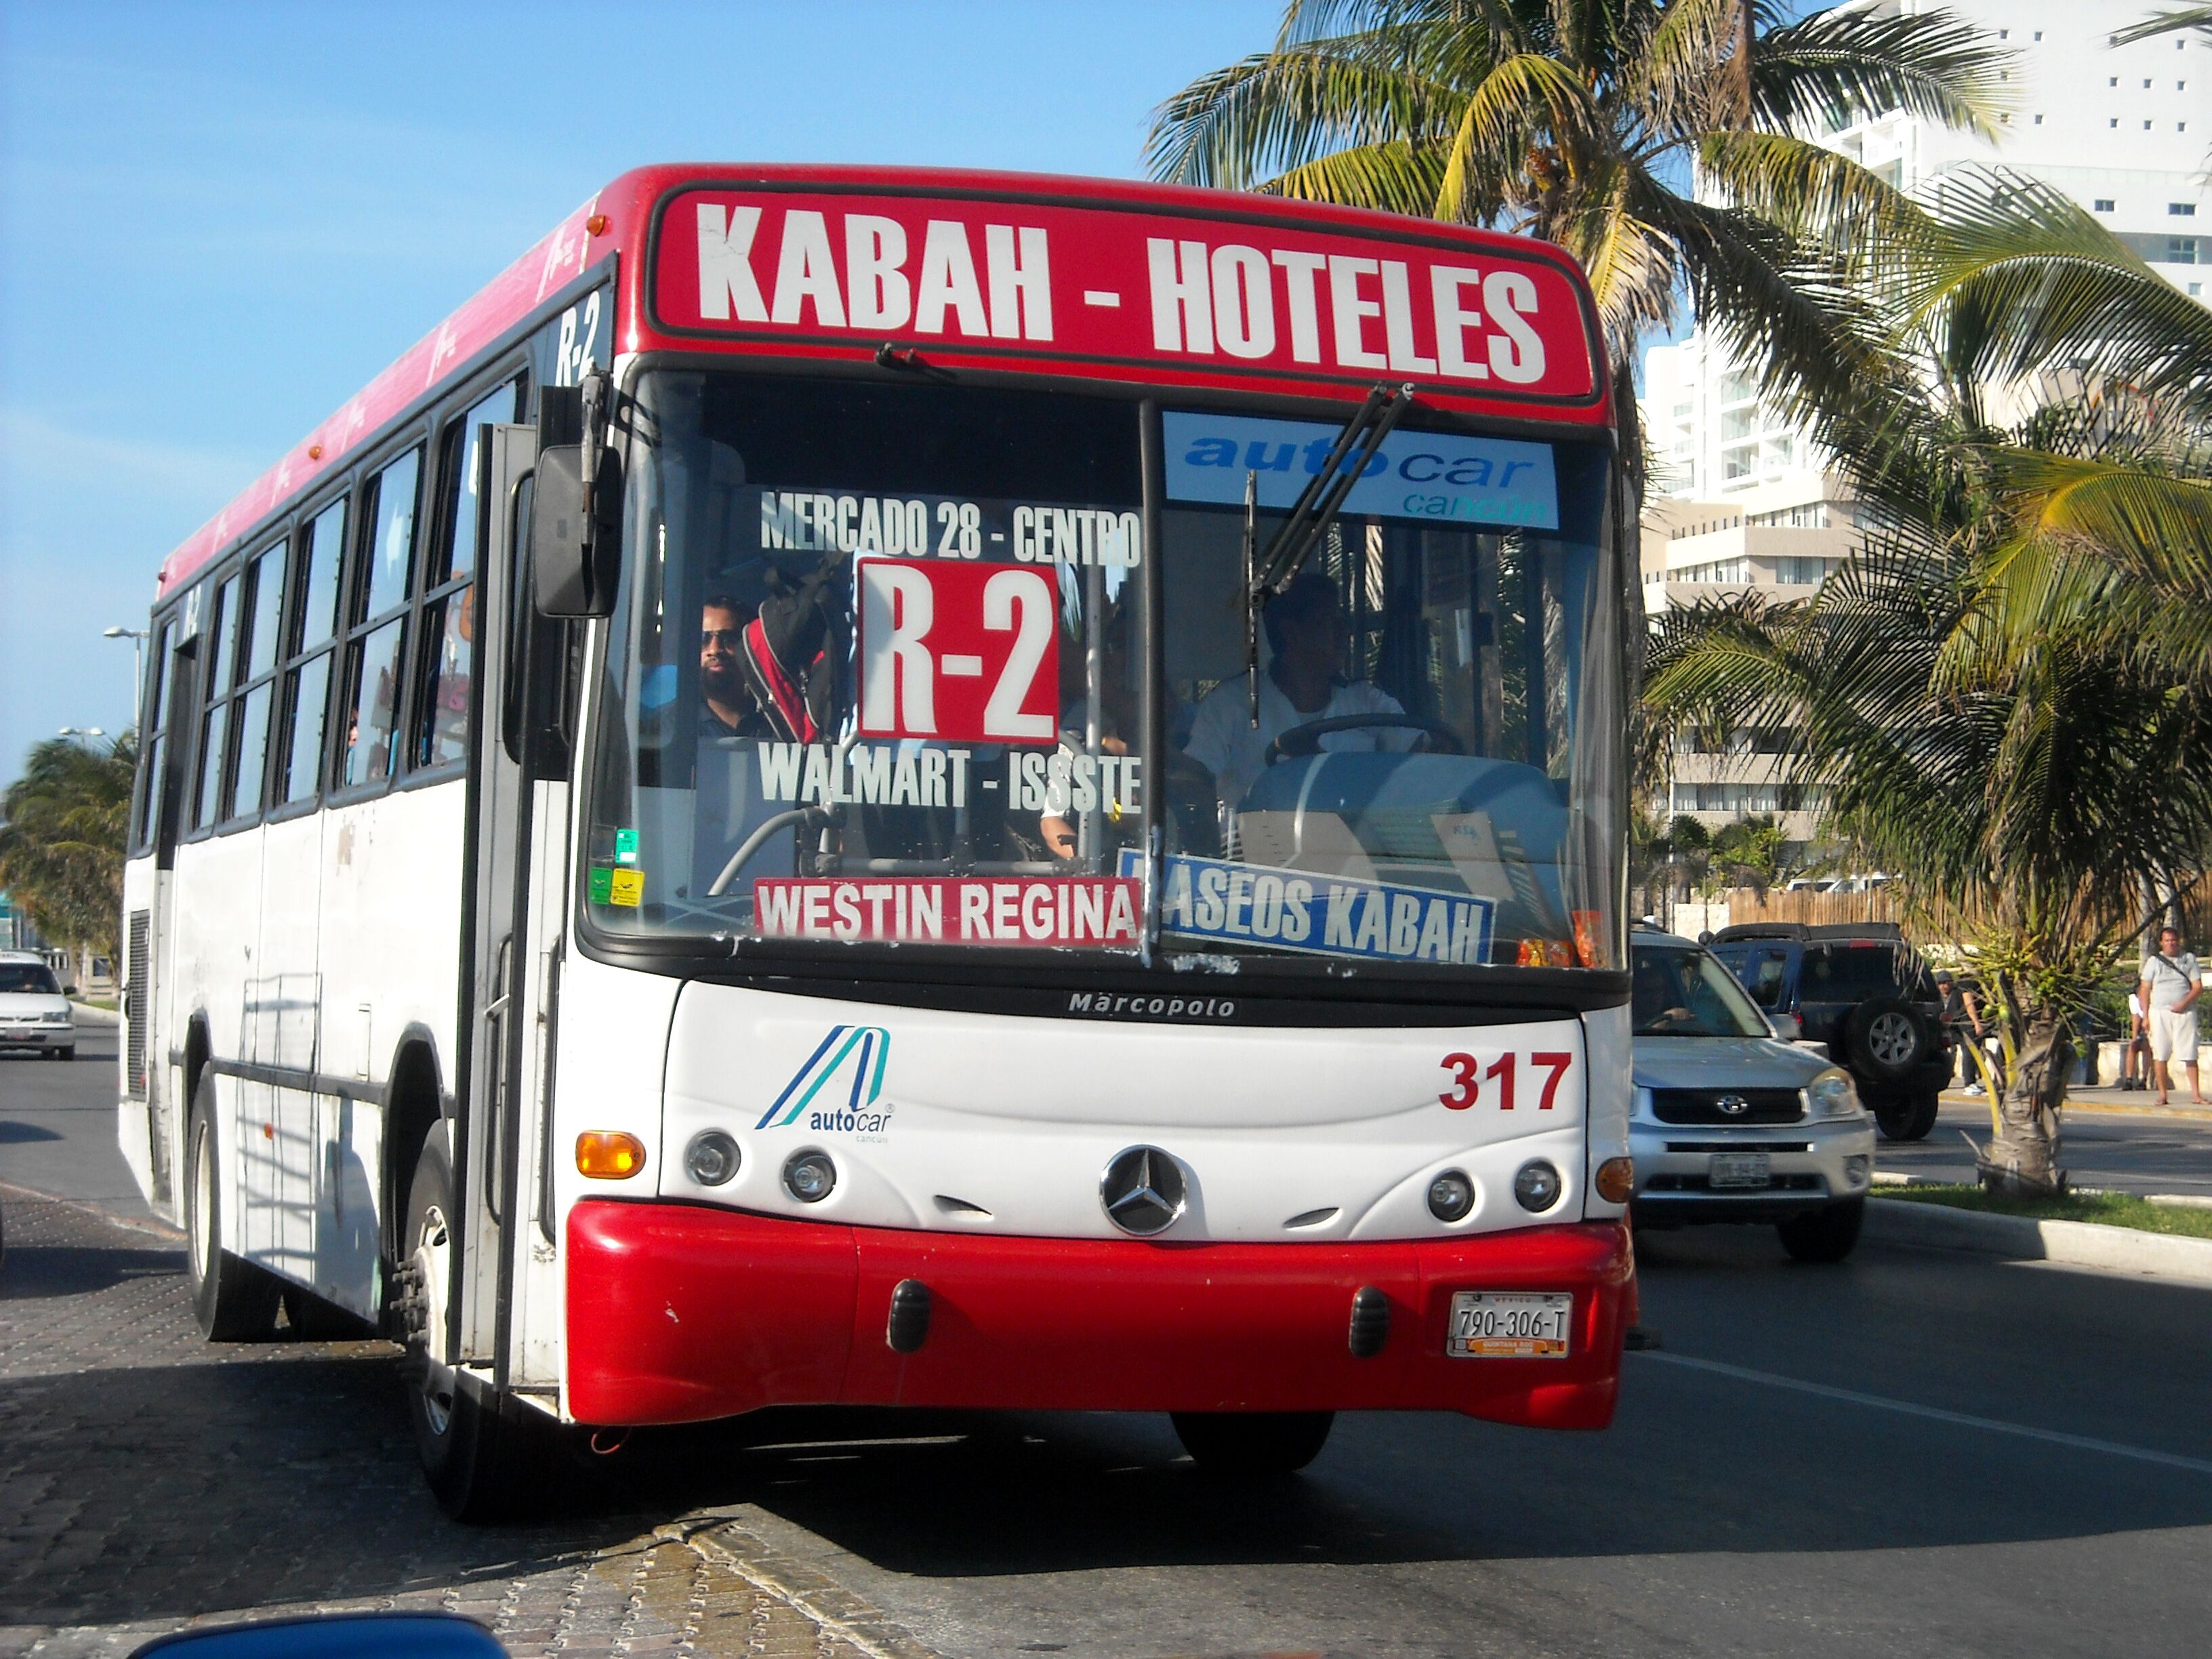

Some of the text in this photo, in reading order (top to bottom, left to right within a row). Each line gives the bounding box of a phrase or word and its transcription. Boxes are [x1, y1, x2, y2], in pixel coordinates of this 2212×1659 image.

[697, 203, 1054, 342] KABAH
[1146, 237, 1547, 385] HOTELES
[760, 491, 928, 557] MERCADO
[937, 501, 981, 560] 28
[1013, 506, 1142, 569] CENTRO
[861, 562, 1054, 739] R-2
[758, 741, 971, 808] WALMART
[1009, 751, 1143, 814] ISSSTE
[758, 882, 1138, 940] WESTIN REGINA
[1324, 885, 1484, 964] KABAH
[1068, 993, 1235, 1017] Marcopolo
[1439, 1051, 1572, 1111] 317
[811, 1107, 891, 1132] autocar
[1458, 1309, 1565, 1338] 790-306-T
